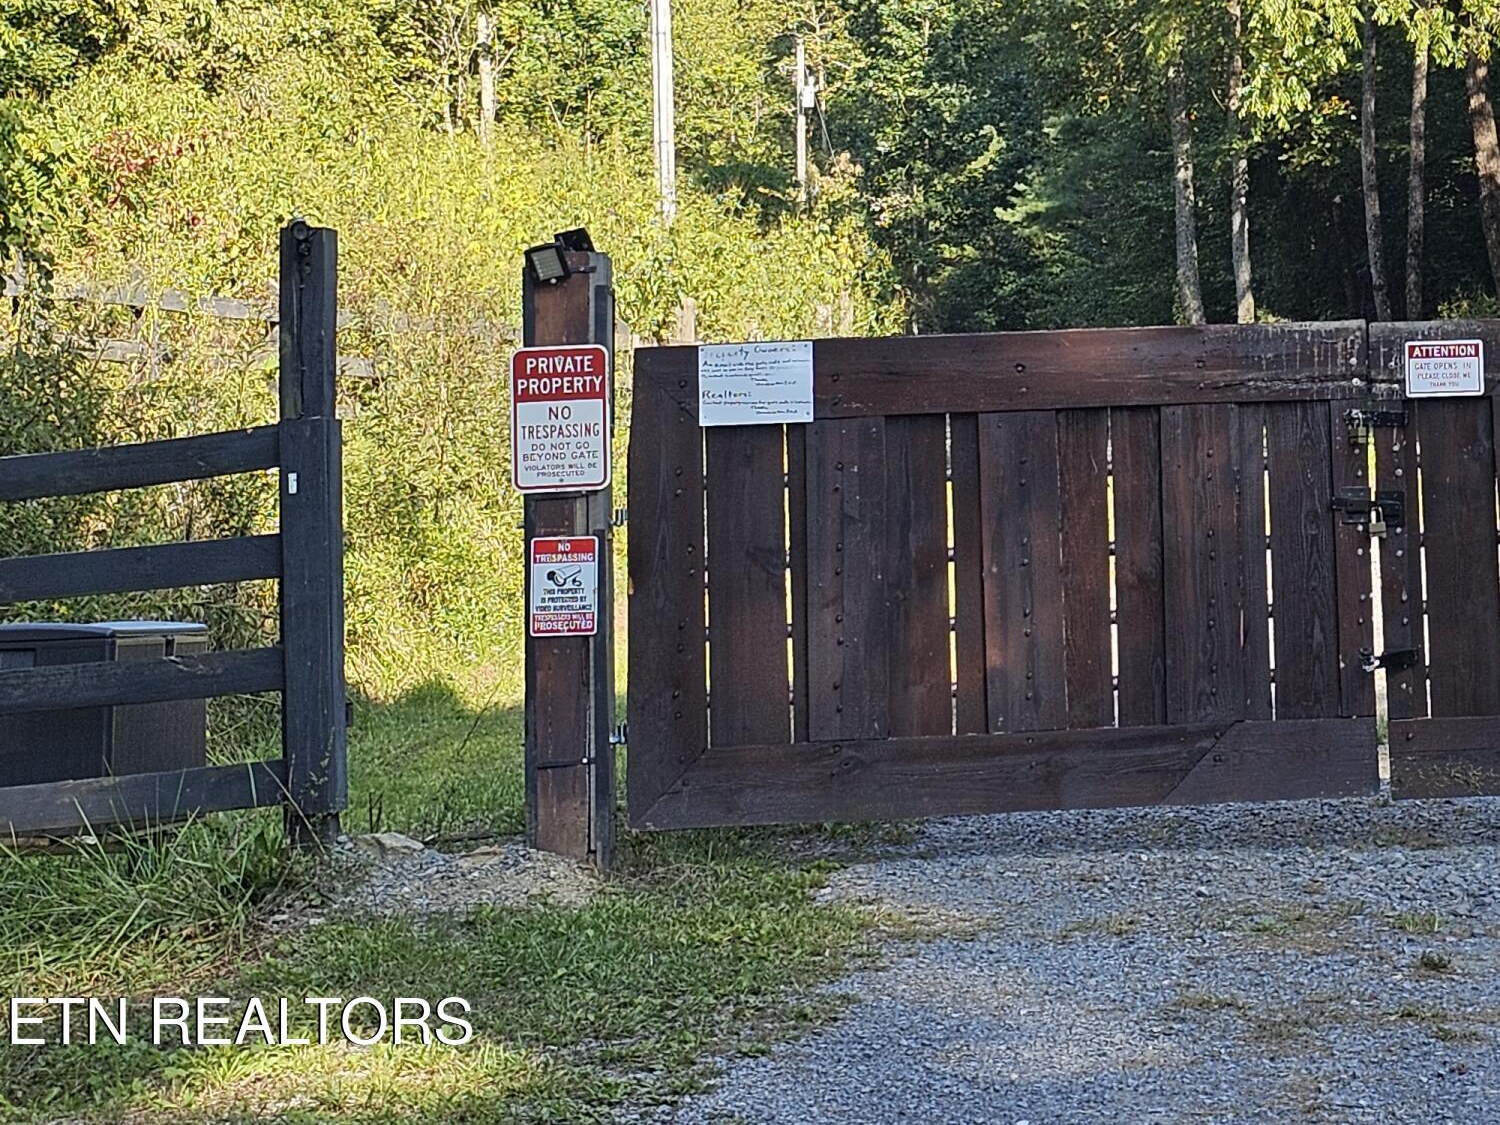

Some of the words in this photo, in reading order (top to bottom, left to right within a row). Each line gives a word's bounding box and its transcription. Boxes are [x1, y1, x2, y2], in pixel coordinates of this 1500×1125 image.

[1412, 345, 1475, 357] ATTENTION
[526, 355, 594, 374] PRIVATE
[517, 376, 603, 395] PROPERTY
[548, 406, 572, 421] NO
[521, 422, 600, 440] TRESPASSING
[531, 443, 546, 452] DO
[550, 442, 571, 451] NOT
[576, 441, 590, 450] GO
[522, 452, 567, 462] BEYOND
[571, 450, 599, 460] GATE
[524, 464, 566, 472] VIOLATORS
[558, 542, 571, 552] NO
[535, 553, 594, 562] TRESPASSING
[534, 620, 592, 630] PROSECUTED
